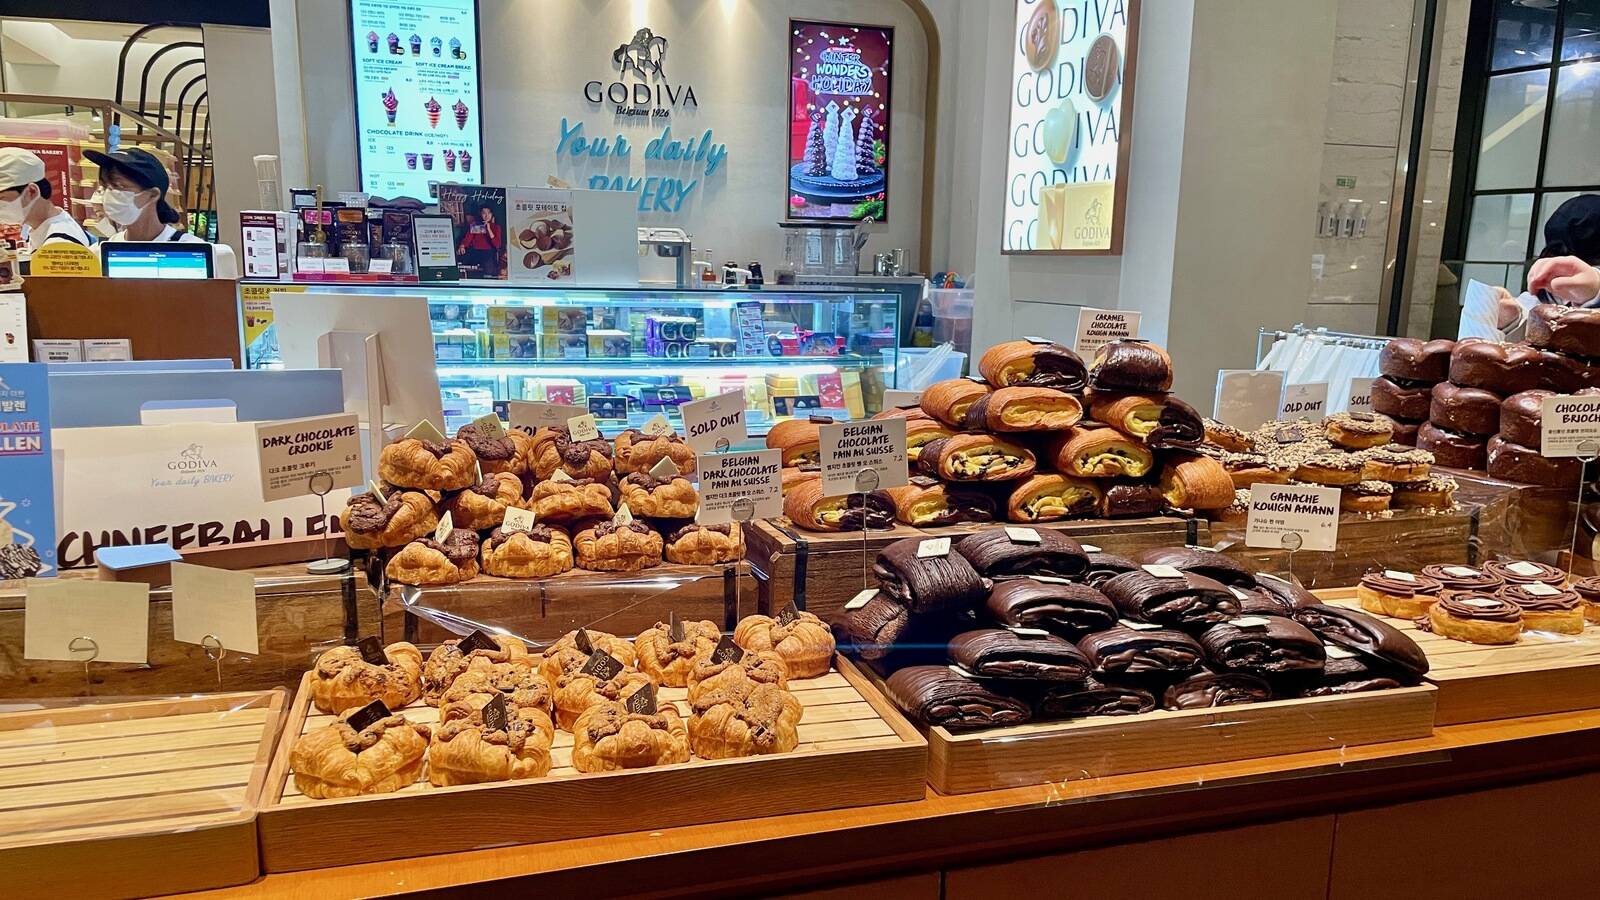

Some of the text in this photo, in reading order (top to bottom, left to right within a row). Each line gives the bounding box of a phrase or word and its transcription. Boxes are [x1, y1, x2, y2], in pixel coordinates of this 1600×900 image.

[816, 63, 868, 79] WONDERS
[811, 75, 872, 93] HOLIDAY
[584, 81, 698, 107] GODIVA
[616, 106, 670, 117] Belgium 1926
[1013, 105, 1119, 158] GOIVA
[556, 117, 728, 176] Your daily
[471, 188, 505, 205] Holiday
[535, 204, 559, 212] 포테이토
[1074, 226, 1110, 240] GODIVA
[1095, 313, 1125, 321] CARAMEL
[1091, 321, 1128, 330] CHOCOLATE
[1086, 329, 1108, 337] KOUIGN
[0, 400, 26, 412] 발렌
[1282, 400, 1322, 413] OLD OUT
[690, 411, 741, 437] SOLD OUT
[843, 424, 883, 438] BELGIAN
[262, 425, 355, 448] DARK CHOCOLATE
[837, 434, 889, 449] CHOCOLATE
[288, 440, 334, 456] CROOKIE
[833, 444, 894, 460] PAIN AU SUISSE
[167, 459, 218, 470] GODIVA
[721, 455, 760, 468] BELGIAN
[841, 461, 856, 469] 초콜릿
[703, 464, 778, 481] DARK CHOCOLATE
[175, 476, 200, 487] daily
[711, 475, 770, 490] PAIN AU SUISSE
[1270, 491, 1320, 504] GANACHE
[1253, 500, 1335, 516] KOUIGN AMANN
[505, 520, 530, 530] GODIVA
